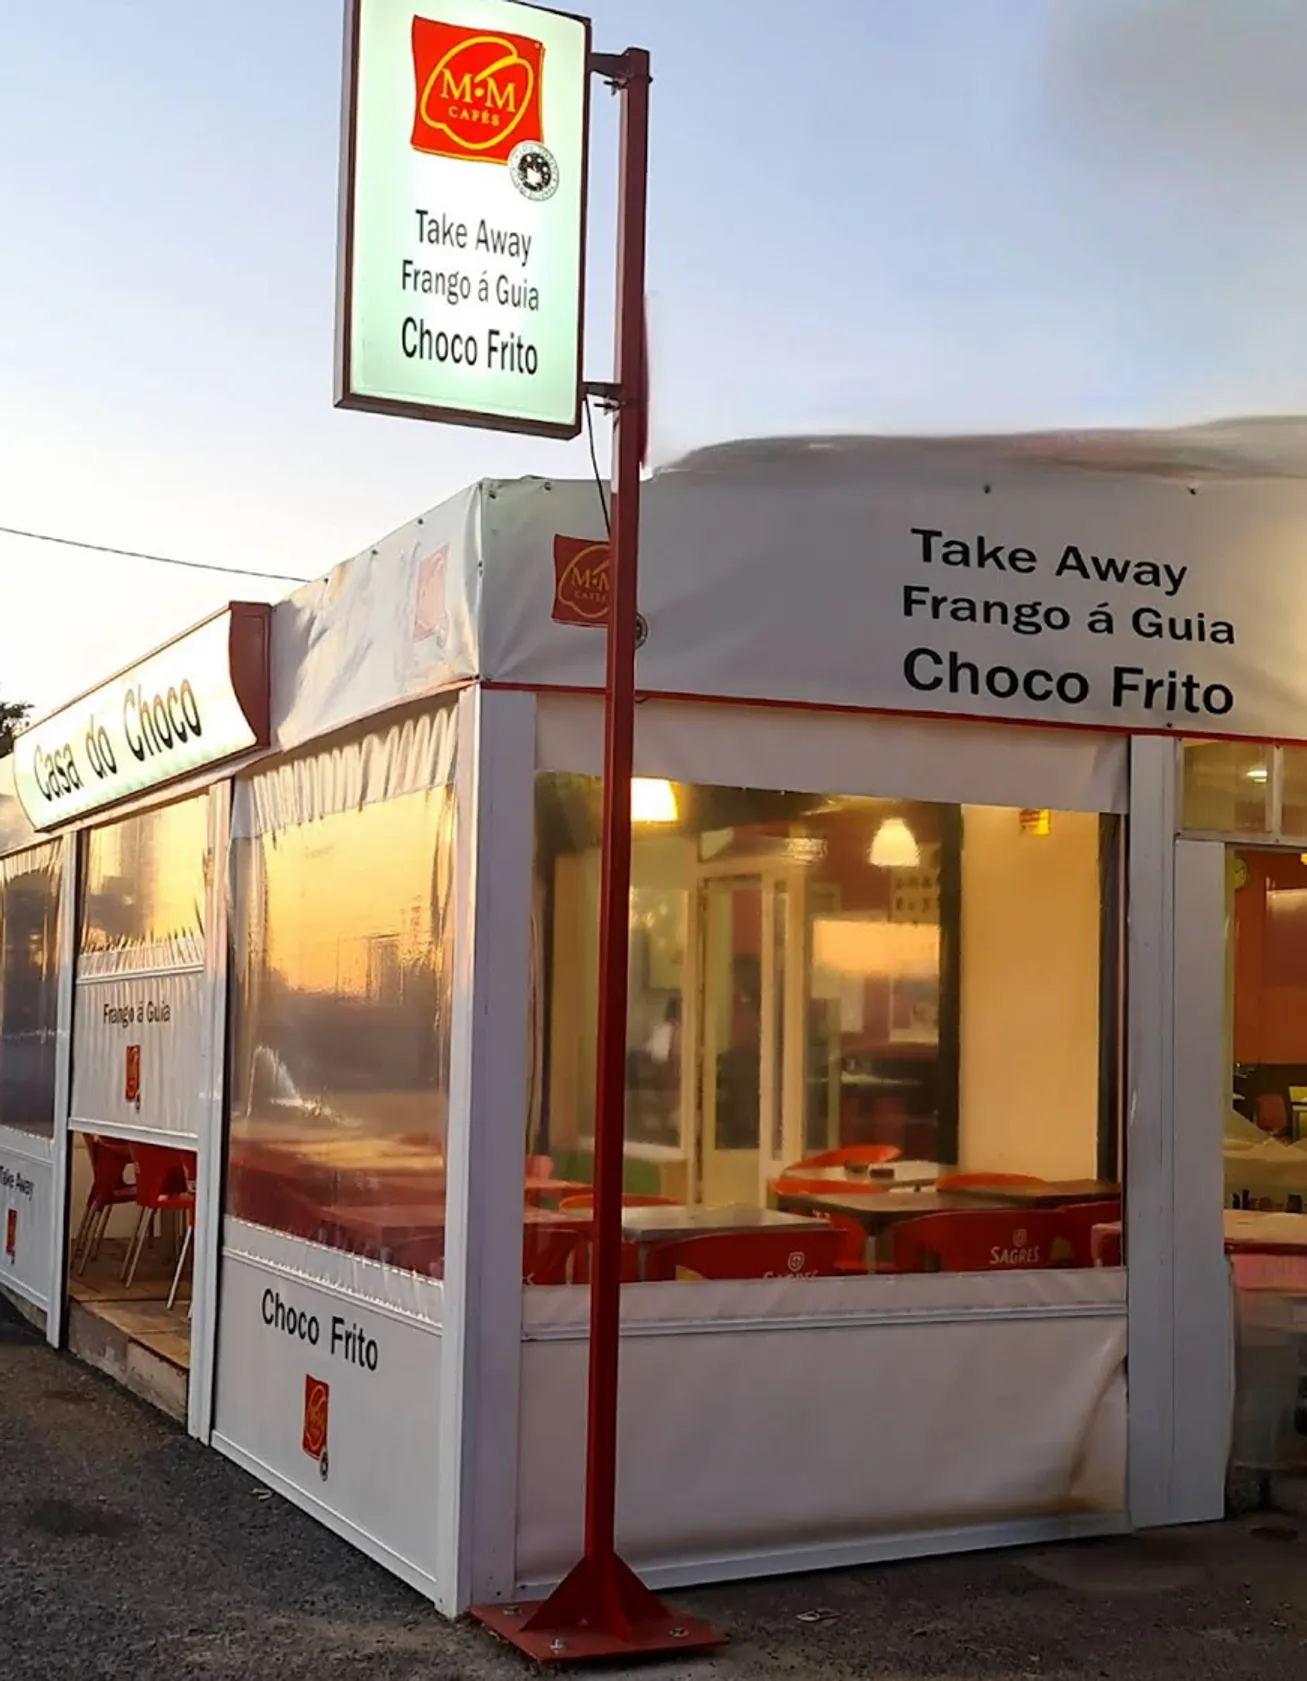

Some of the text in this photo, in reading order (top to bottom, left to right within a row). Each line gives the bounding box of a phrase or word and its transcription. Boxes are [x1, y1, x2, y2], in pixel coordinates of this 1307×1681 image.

[448, 106, 500, 126] CAFÉS
[415, 209, 532, 267] Take Away
[402, 259, 539, 311] Frango á Guia
[402, 316, 538, 375] Choco Frito
[910, 528, 1187, 596] Take Away
[903, 585, 1235, 644] Frango á Guia
[903, 647, 1234, 714] Choco Frito
[34, 679, 202, 801] Casa do Choco
[989, 1245, 1040, 1265] SAGRES
[262, 1288, 378, 1371] Choco Frito
